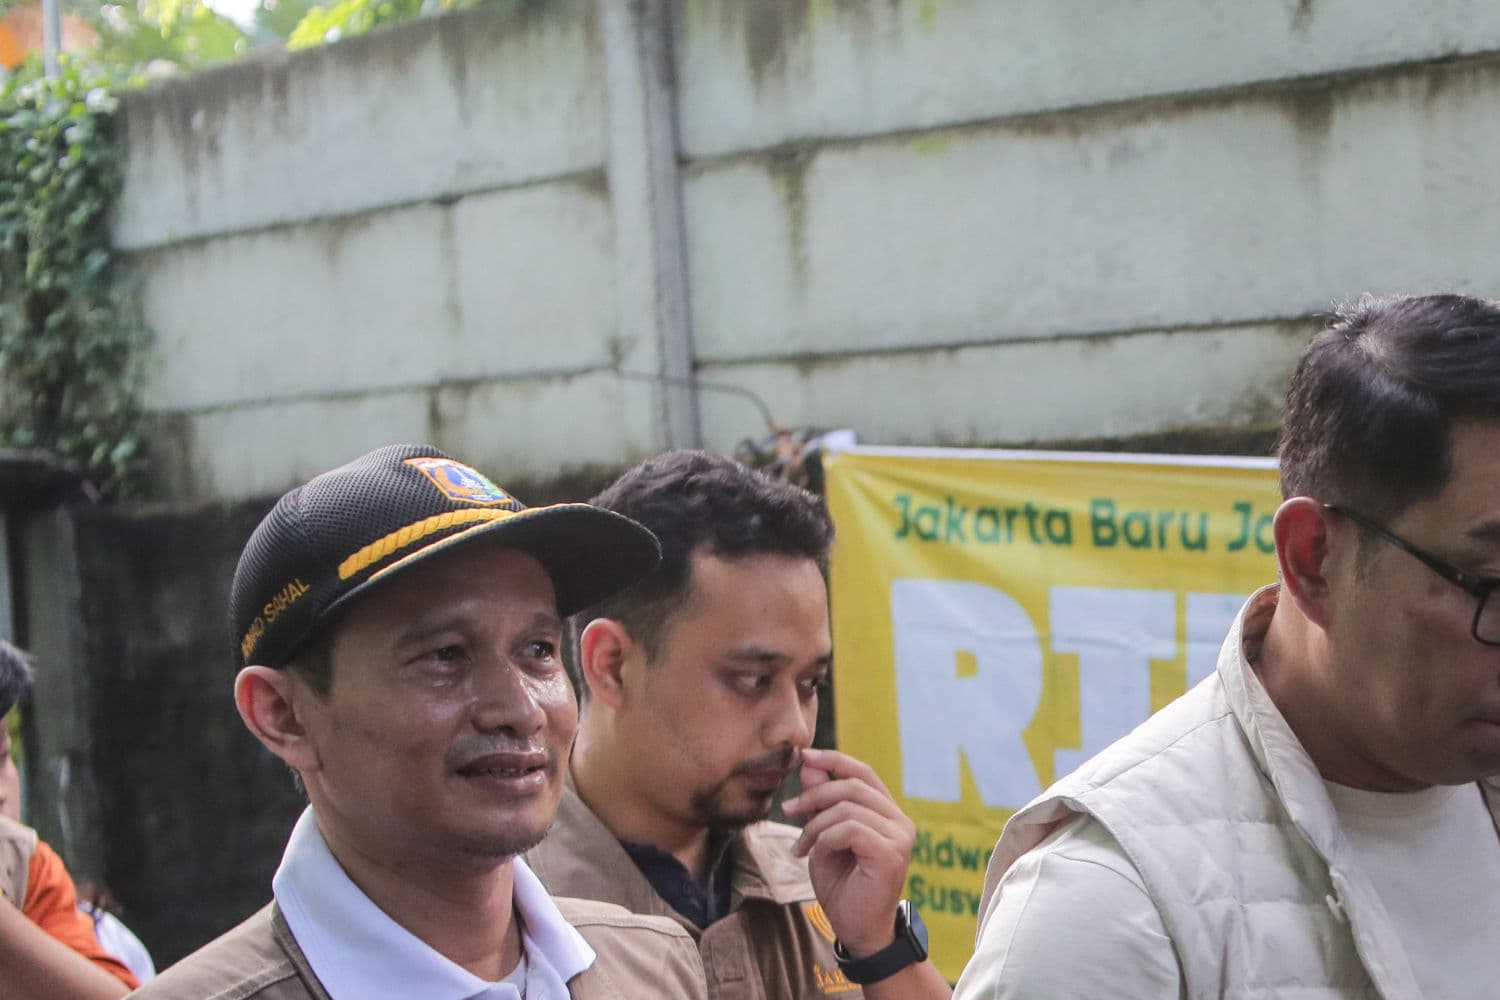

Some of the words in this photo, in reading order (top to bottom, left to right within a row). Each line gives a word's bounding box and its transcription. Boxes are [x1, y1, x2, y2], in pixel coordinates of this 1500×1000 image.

[894, 494, 1073, 546] Jakarta
[1089, 498, 1208, 552] Baru
[1227, 502, 1277, 554] Ja
